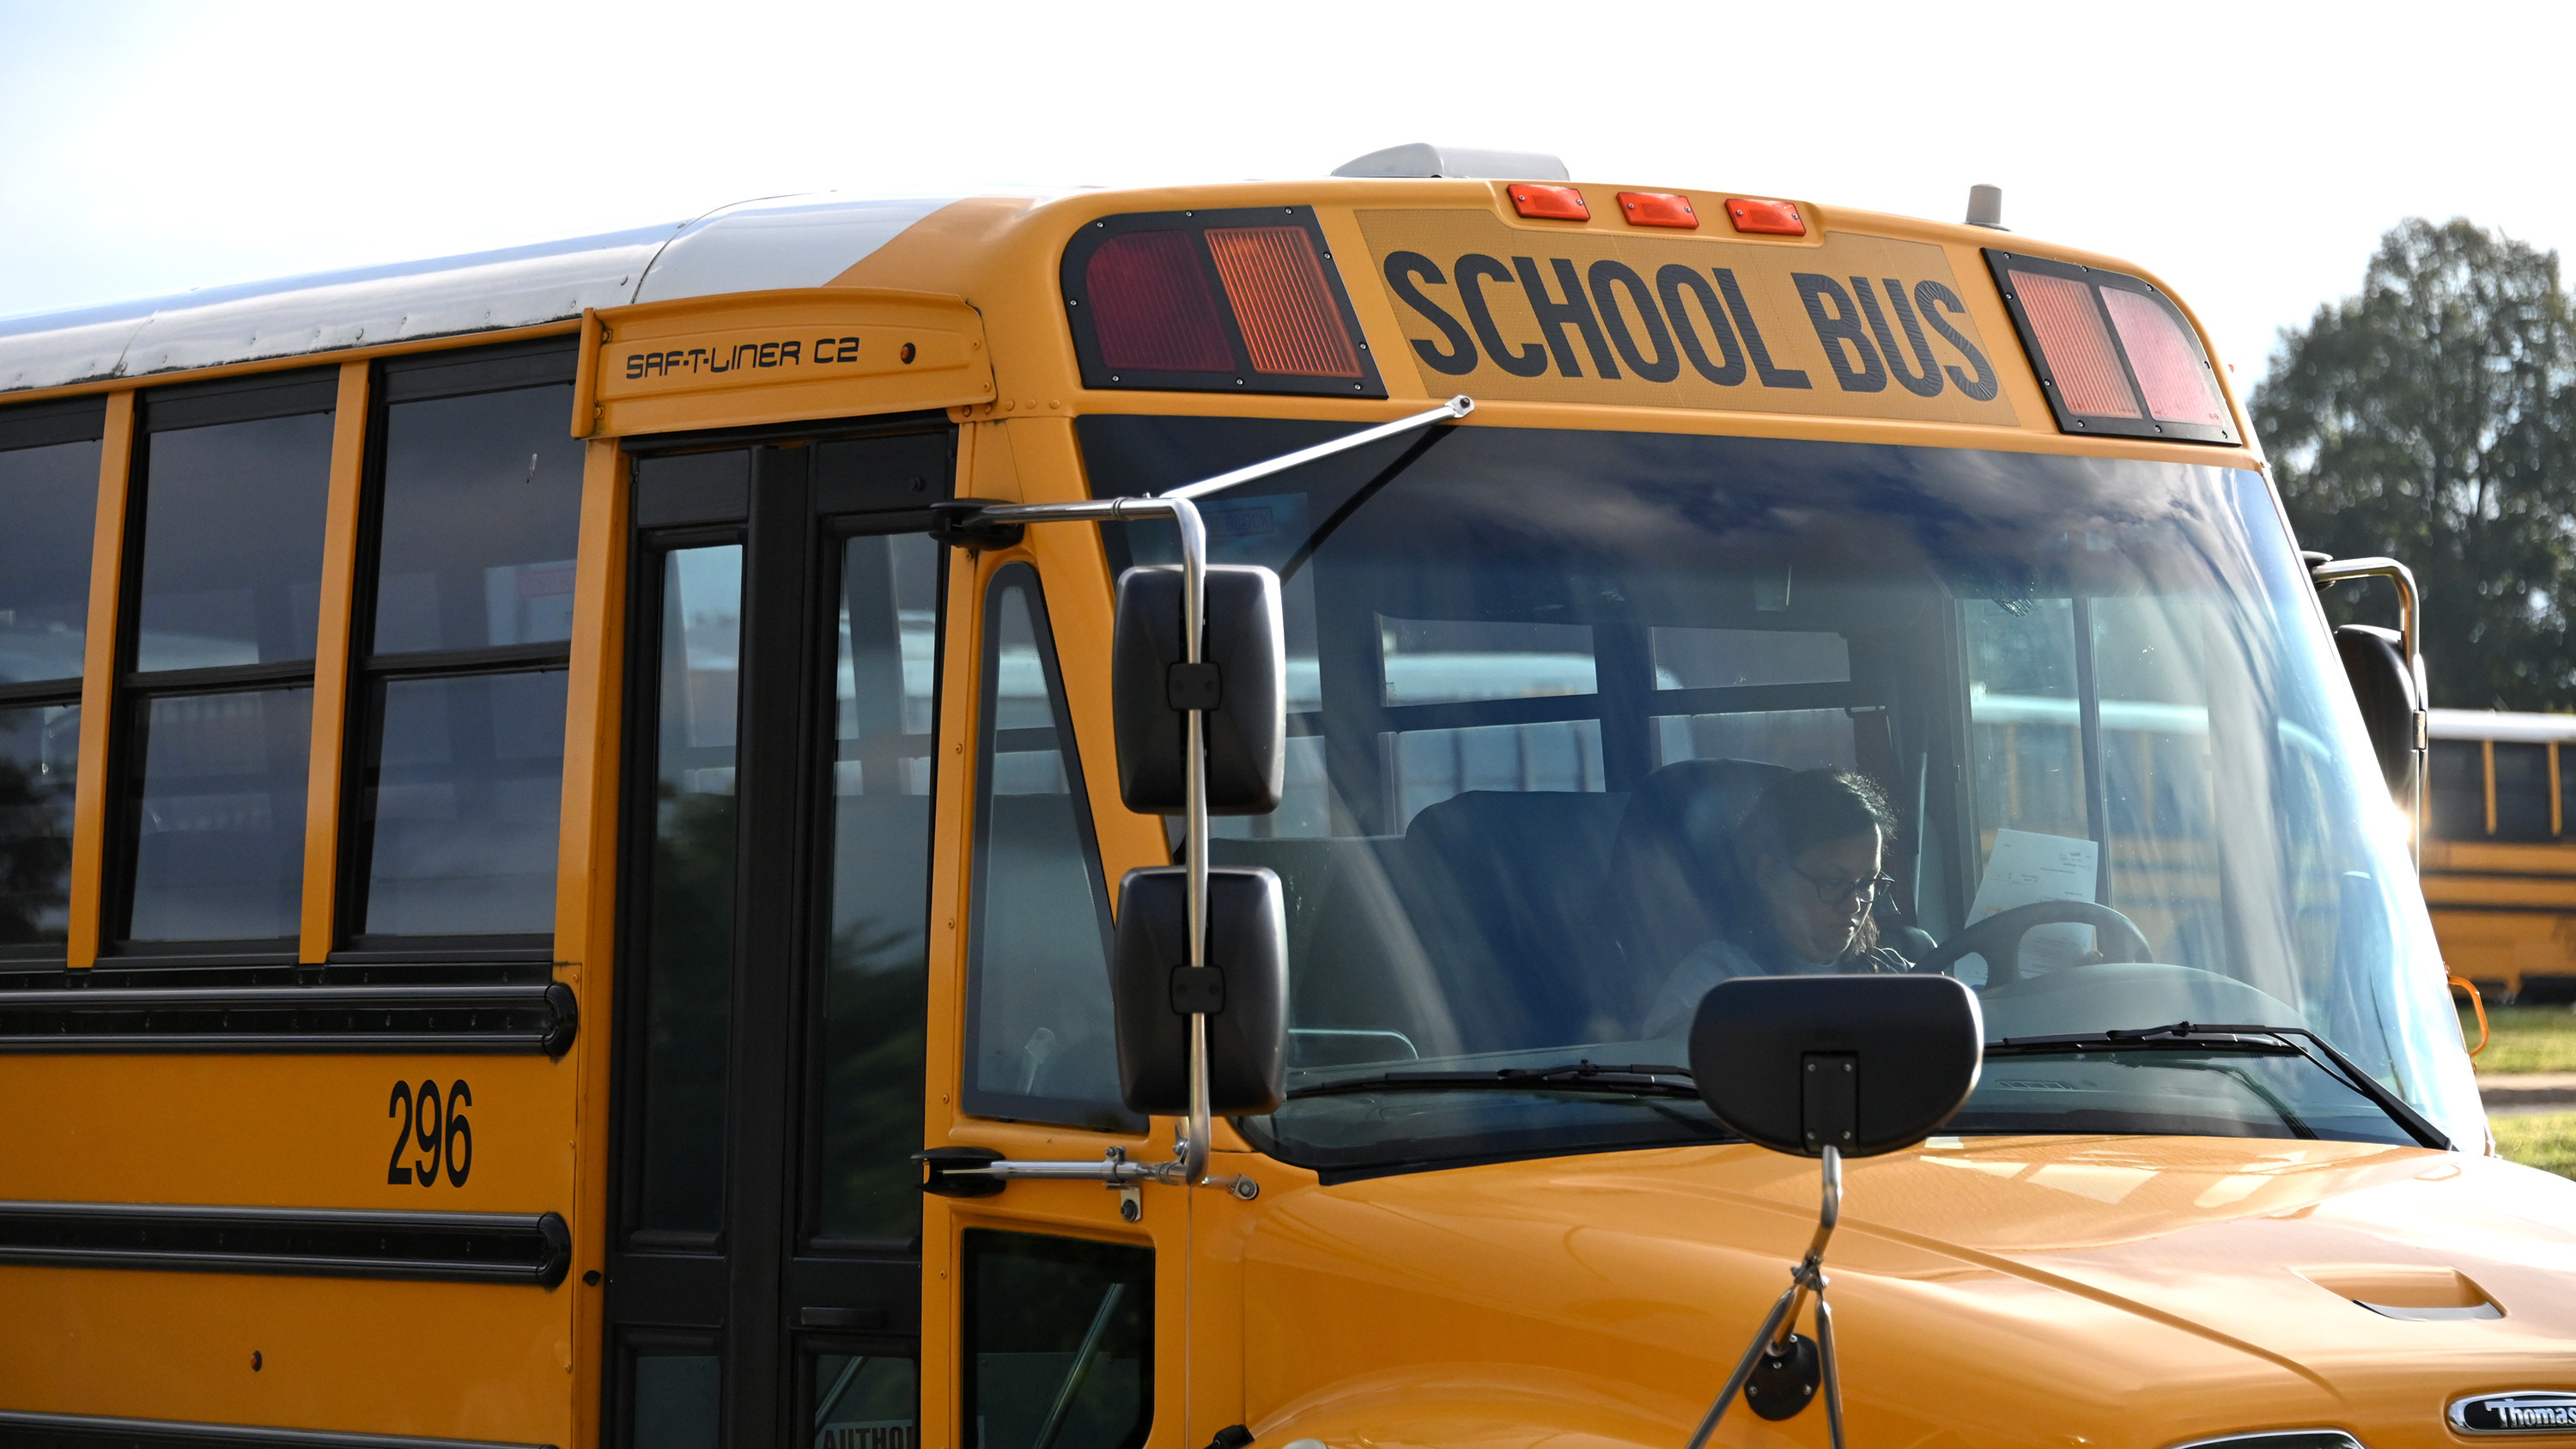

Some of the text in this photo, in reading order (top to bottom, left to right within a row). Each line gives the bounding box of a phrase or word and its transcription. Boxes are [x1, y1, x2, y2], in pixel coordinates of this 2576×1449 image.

[626, 337, 860, 380] SAF-T-LINER C2
[1383, 250, 1998, 402] SCHOOL BUS
[387, 1079, 472, 1188] 296
[2484, 1398, 2576, 1428] Thomas
